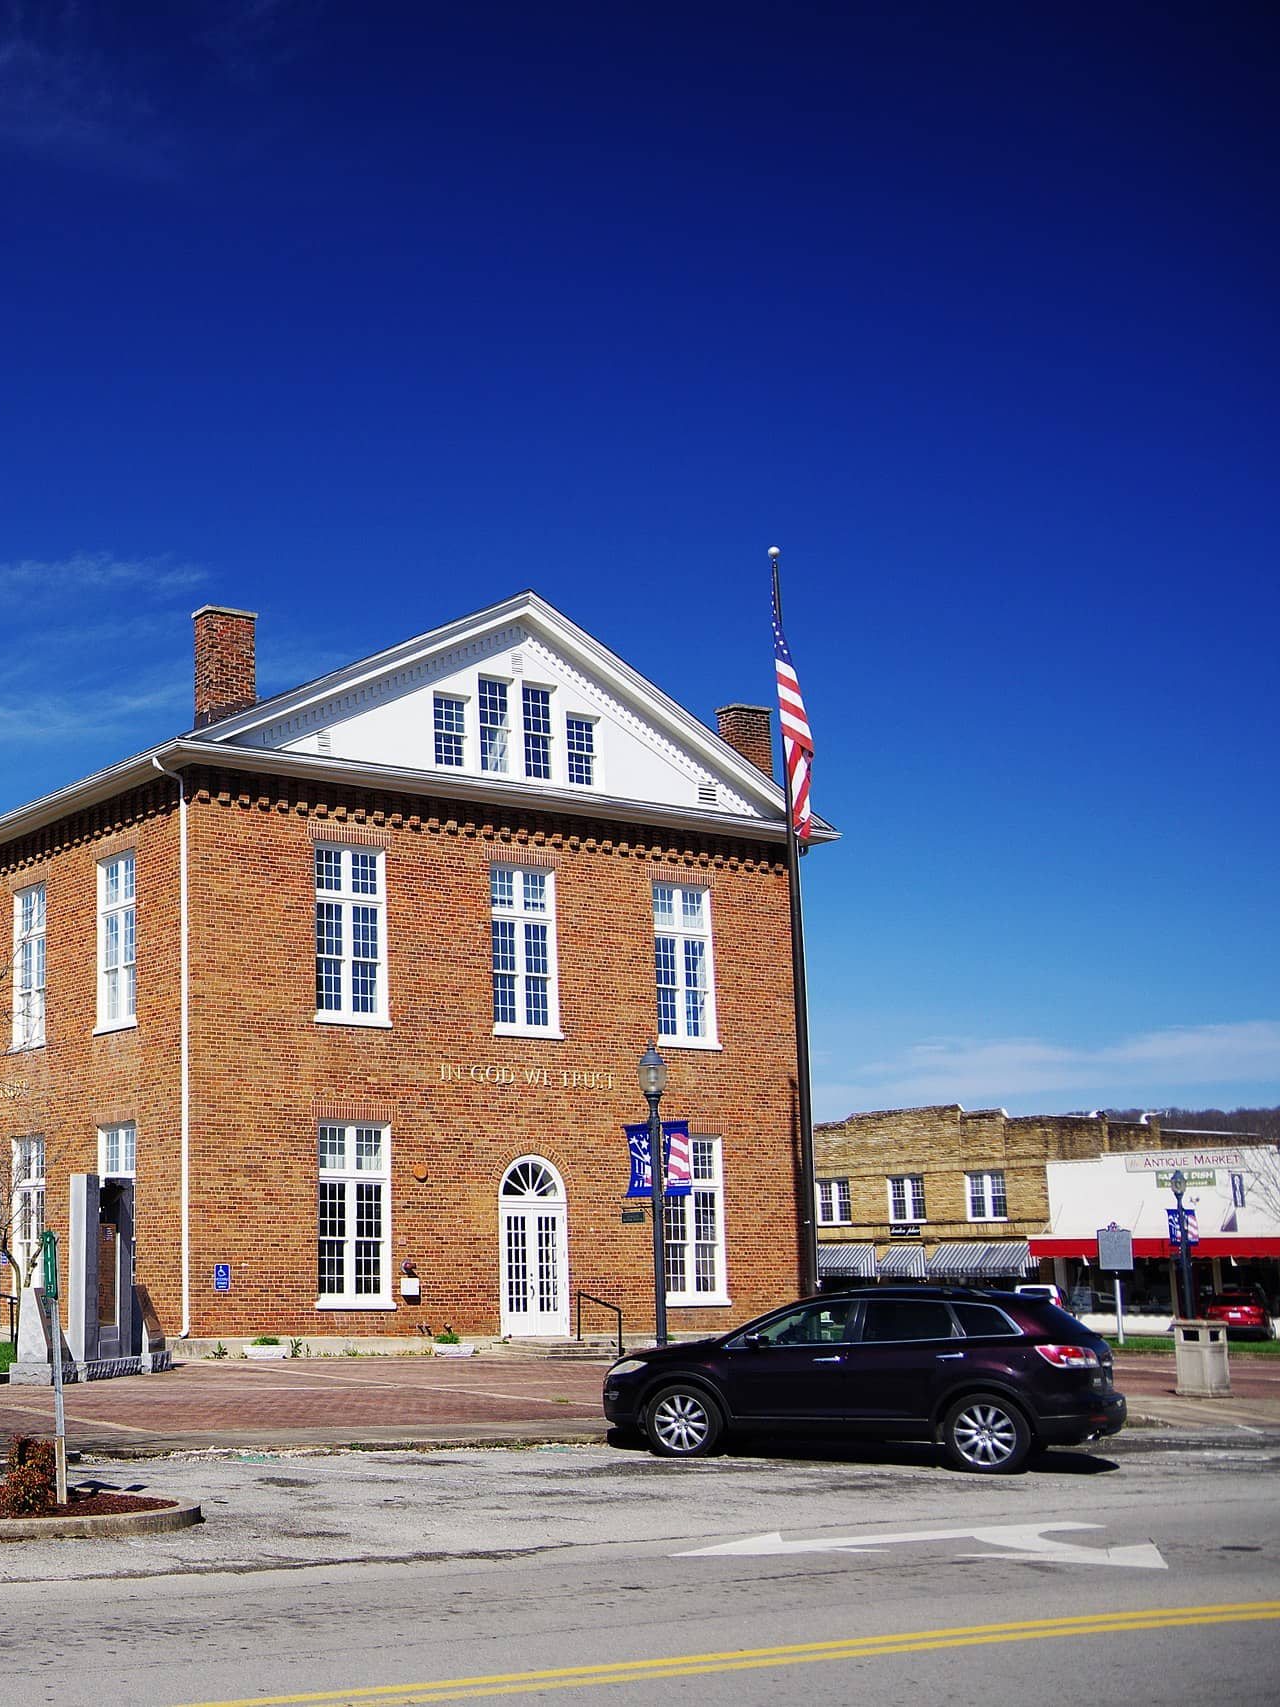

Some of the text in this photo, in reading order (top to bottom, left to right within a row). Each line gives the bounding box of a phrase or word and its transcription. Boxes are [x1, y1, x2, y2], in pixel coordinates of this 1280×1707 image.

[440, 1064, 616, 1090] IN GOD WE TRUST
[1143, 1157, 1190, 1168] ANTIQUE
[1194, 1154, 1240, 1166] MARKET
[1191, 1171, 1213, 1179] DISH
